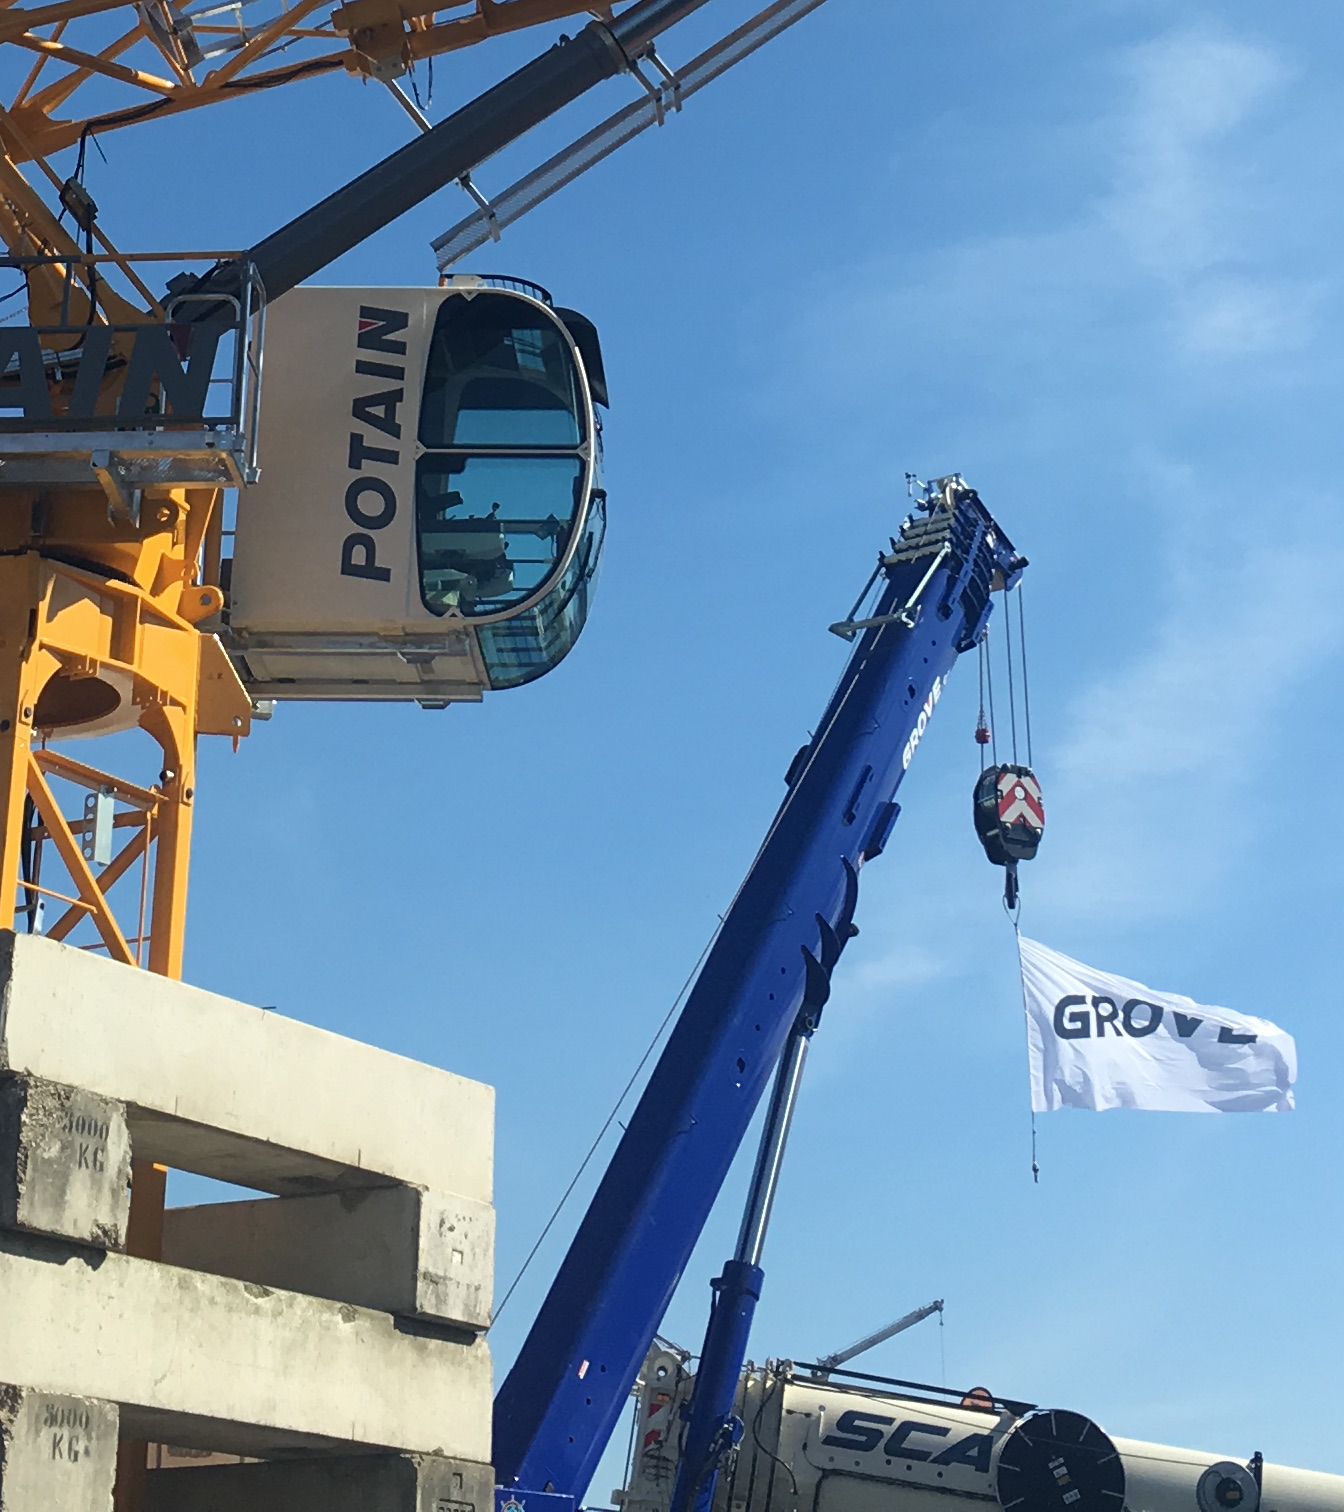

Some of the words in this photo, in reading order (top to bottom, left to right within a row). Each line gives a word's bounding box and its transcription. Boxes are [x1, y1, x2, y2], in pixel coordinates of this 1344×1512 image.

[340, 305, 410, 583] POTAIN
[902, 675, 942, 770] GROVE
[78, 1142, 105, 1172] KG
